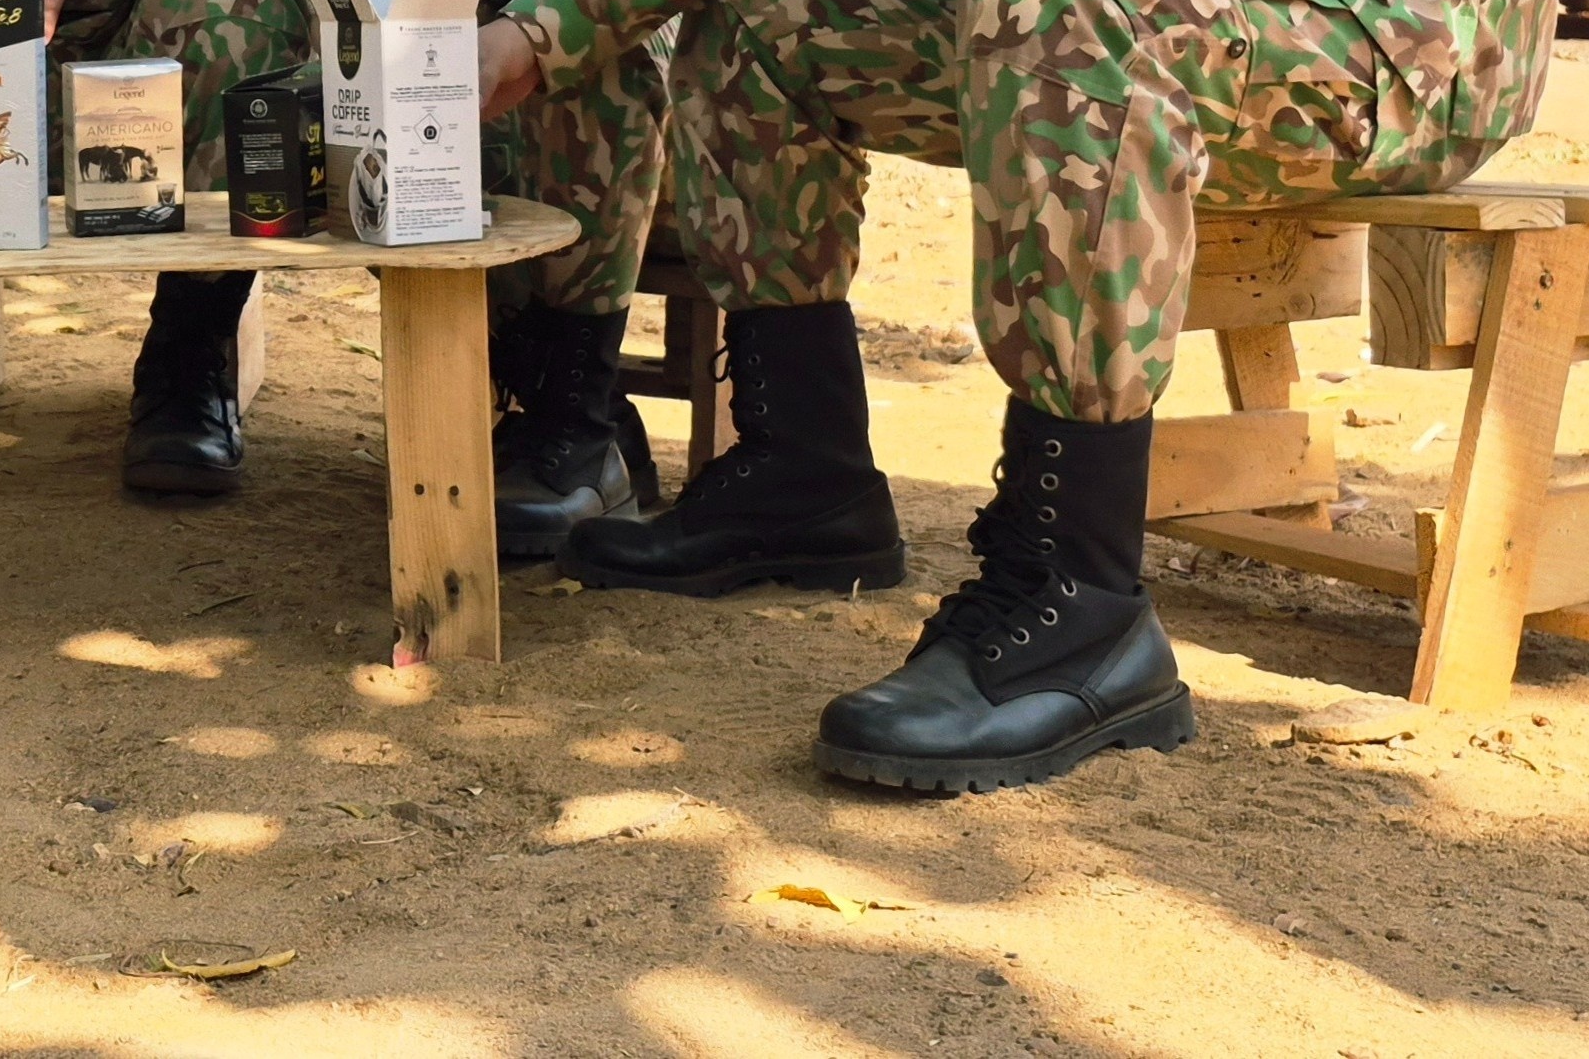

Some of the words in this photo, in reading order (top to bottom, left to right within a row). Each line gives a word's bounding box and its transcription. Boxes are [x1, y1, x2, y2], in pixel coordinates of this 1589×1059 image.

[8, 7, 23, 24] 8
[339, 50, 360, 64] Legend
[114, 89, 145, 100] Legend
[338, 88, 361, 104] DRIP
[332, 105, 370, 122] COFFEE
[86, 121, 173, 137] AMERICANO
